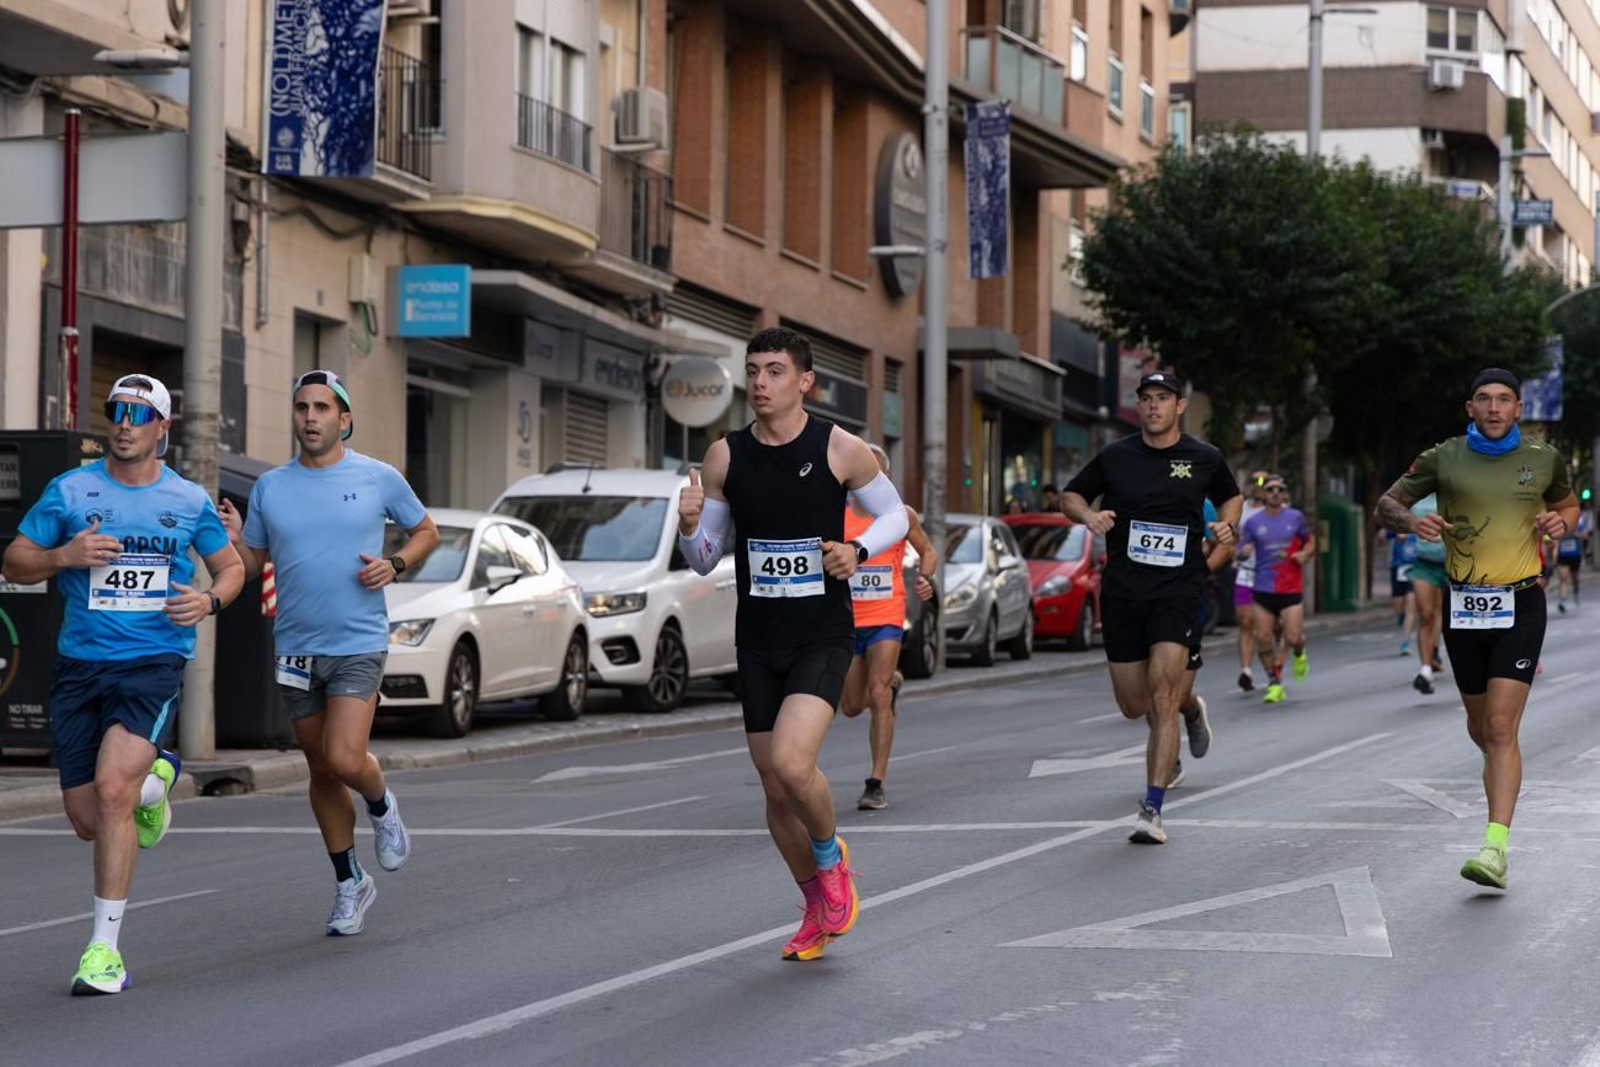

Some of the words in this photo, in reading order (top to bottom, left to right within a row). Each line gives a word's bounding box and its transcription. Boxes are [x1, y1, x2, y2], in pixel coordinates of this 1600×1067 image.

[1140, 534, 1175, 551] 674
[761, 556, 809, 576] 498
[105, 569, 155, 590] 487
[861, 574, 881, 587] 80
[1463, 596, 1503, 612] 892
[276, 656, 306, 670] 18
